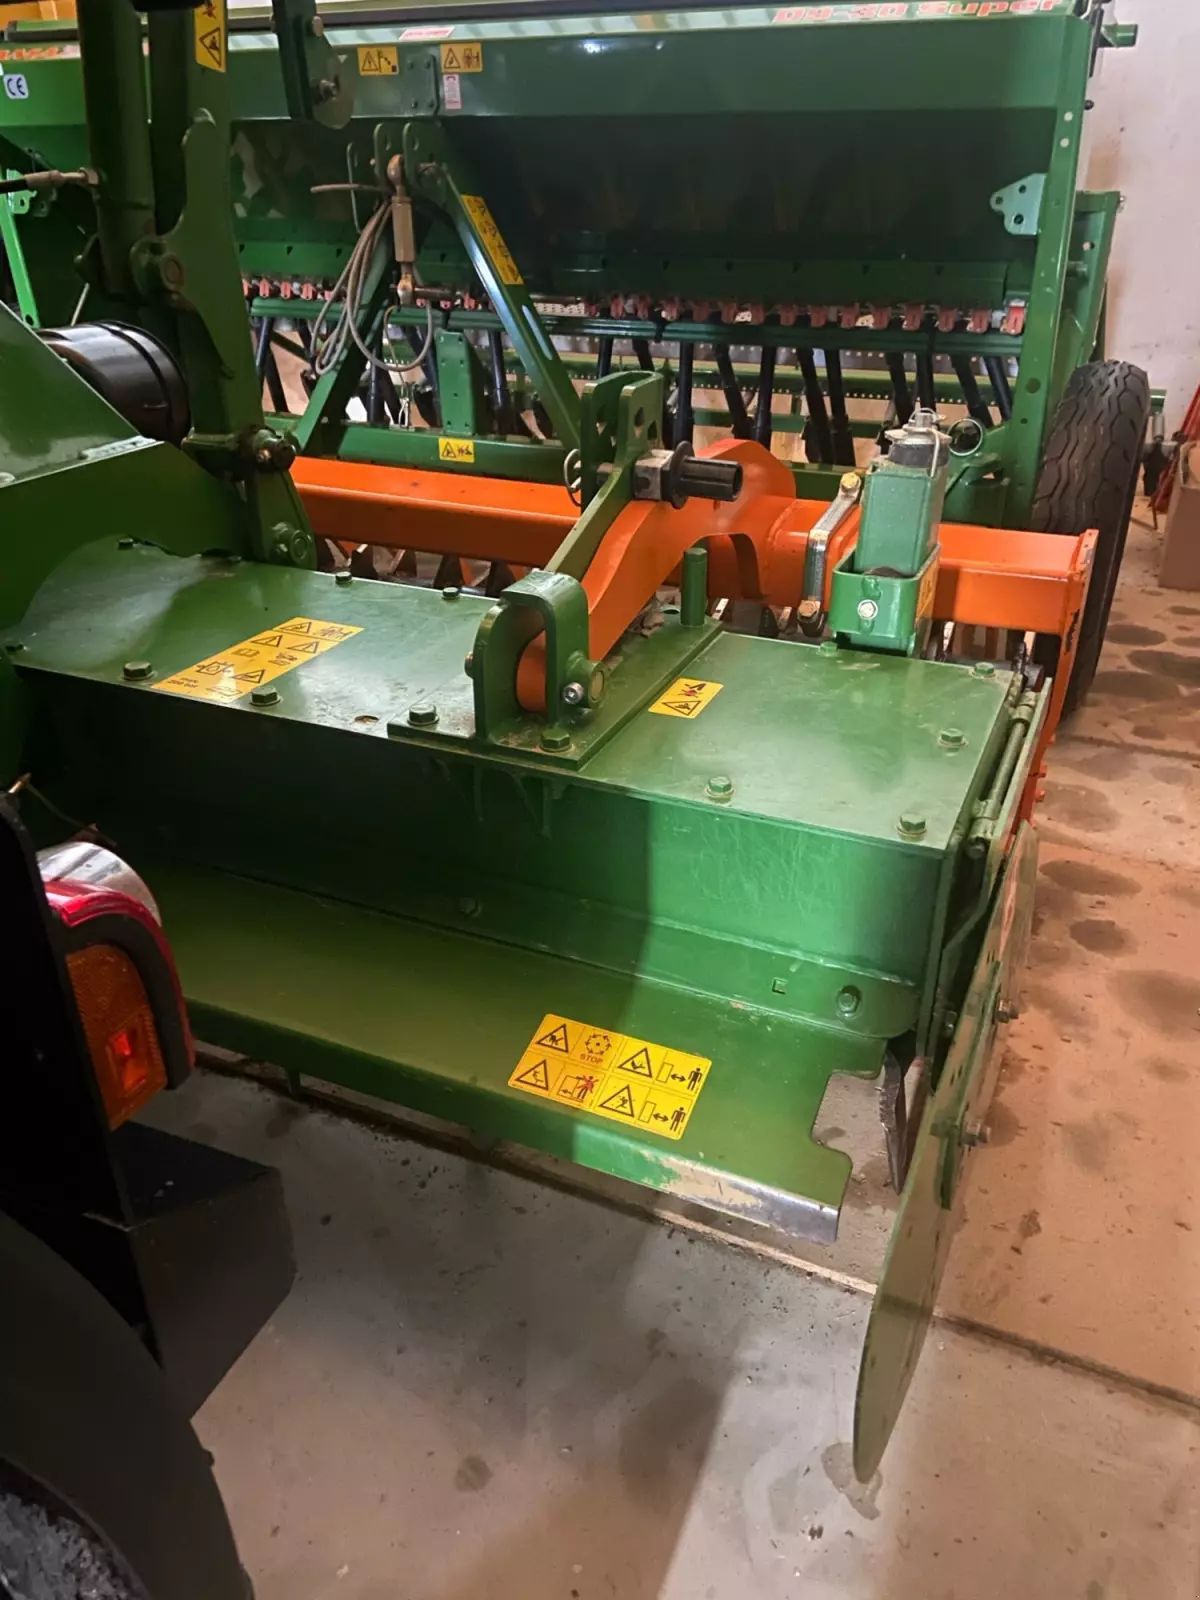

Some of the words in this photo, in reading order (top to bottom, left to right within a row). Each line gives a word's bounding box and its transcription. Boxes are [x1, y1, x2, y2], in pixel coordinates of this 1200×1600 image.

[916, 0, 1062, 17] Super
[7, 77, 26, 96] CE
[580, 1053, 604, 1065] STOP
